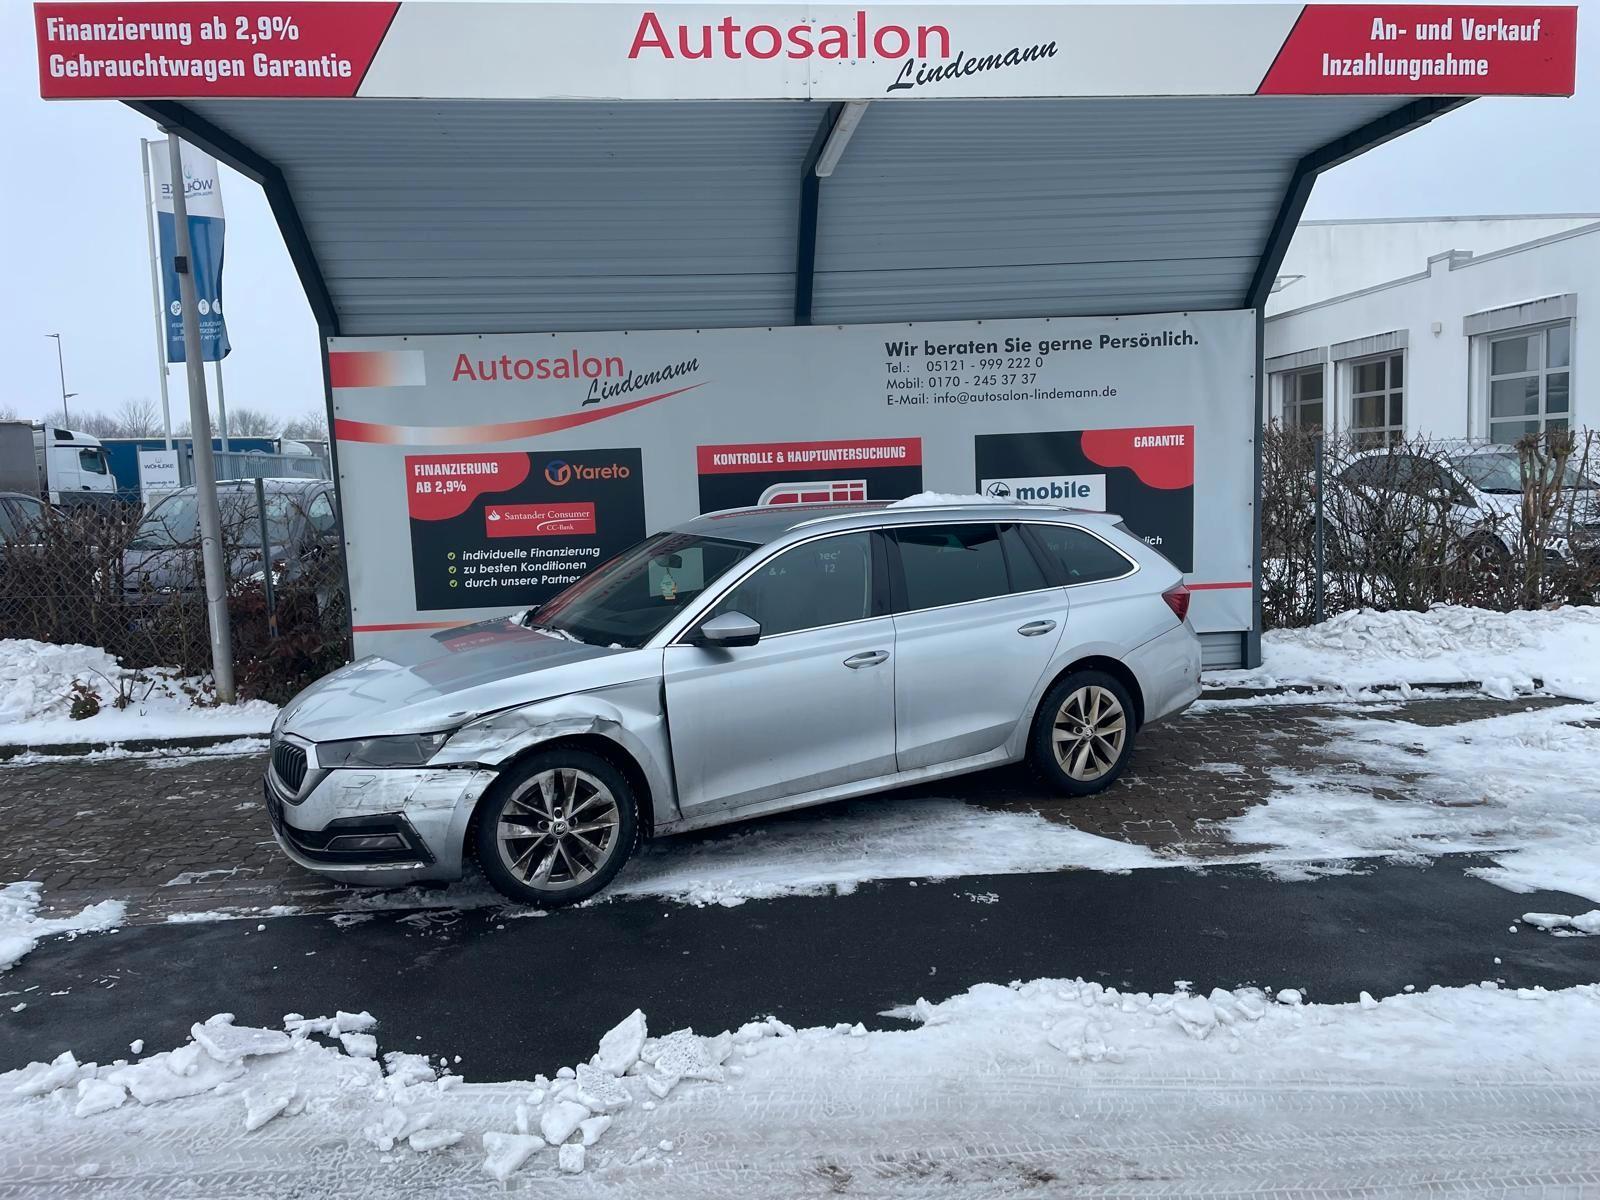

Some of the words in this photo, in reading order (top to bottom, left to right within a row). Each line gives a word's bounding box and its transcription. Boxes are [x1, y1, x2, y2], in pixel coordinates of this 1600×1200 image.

[46, 17, 192, 46] Finanzierung
[200, 16, 227, 40] ab
[235, 16, 299, 44] 2,9%
[627, 11, 950, 59] Autosalon
[1371, 18, 1407, 41] An-
[1416, 18, 1453, 41] und
[1461, 18, 1541, 42] Verkauf
[49, 53, 246, 82] Gebrauchtwagen
[252, 52, 352, 77] Garantie
[886, 40, 1058, 92] Lindemann
[1322, 53, 1489, 81] Inzahlungnahme
[884, 341, 919, 357] Wir
[924, 340, 998, 356] beraten
[1004, 337, 1032, 352] Sie
[1038, 338, 1093, 355] gerne
[1099, 329, 1199, 349] Persönlich.
[452, 349, 625, 381] Autosalon
[885, 362, 910, 373] Tel.:
[926, 360, 964, 372] 05121
[979, 358, 1003, 370] 999
[1007, 357, 1031, 369] 222
[1035, 356, 1043, 368] 0
[581, 357, 700, 407] Lindemann
[886, 377, 924, 389] Mobil:
[928, 376, 960, 388] 0170
[973, 375, 997, 386] 245
[1001, 374, 1017, 385] 37
[1021, 373, 1037, 384] 37
[887, 393, 929, 405] E-Mail:
[934, 385, 1117, 404] info@autosalon-lindemann.de
[1134, 434, 1185, 448] GARANTIE
[713, 452, 773, 466] KONTROLLE
[776, 451, 785, 463] &
[787, 446, 906, 463] HAUPTUNTERSUCHUNG
[414, 462, 499, 476] FINANZIERUNG
[572, 464, 630, 480] Yareto
[415, 481, 432, 494] AB
[435, 481, 467, 495] 2,9%
[1016, 481, 1091, 500] mobile
[504, 510, 546, 521] Santander
[547, 510, 590, 519] Consumer
[546, 523, 574, 531] CC-Bank
[1142, 535, 1162, 545] lich
[463, 548, 527, 560] individuelle
[531, 547, 600, 558] Finanzierung
[464, 566, 477, 574] zu
[479, 561, 517, 573] besten
[521, 561, 587, 572] Konditionen
[465, 576, 497, 588] durch
[501, 576, 538, 586] unsere
